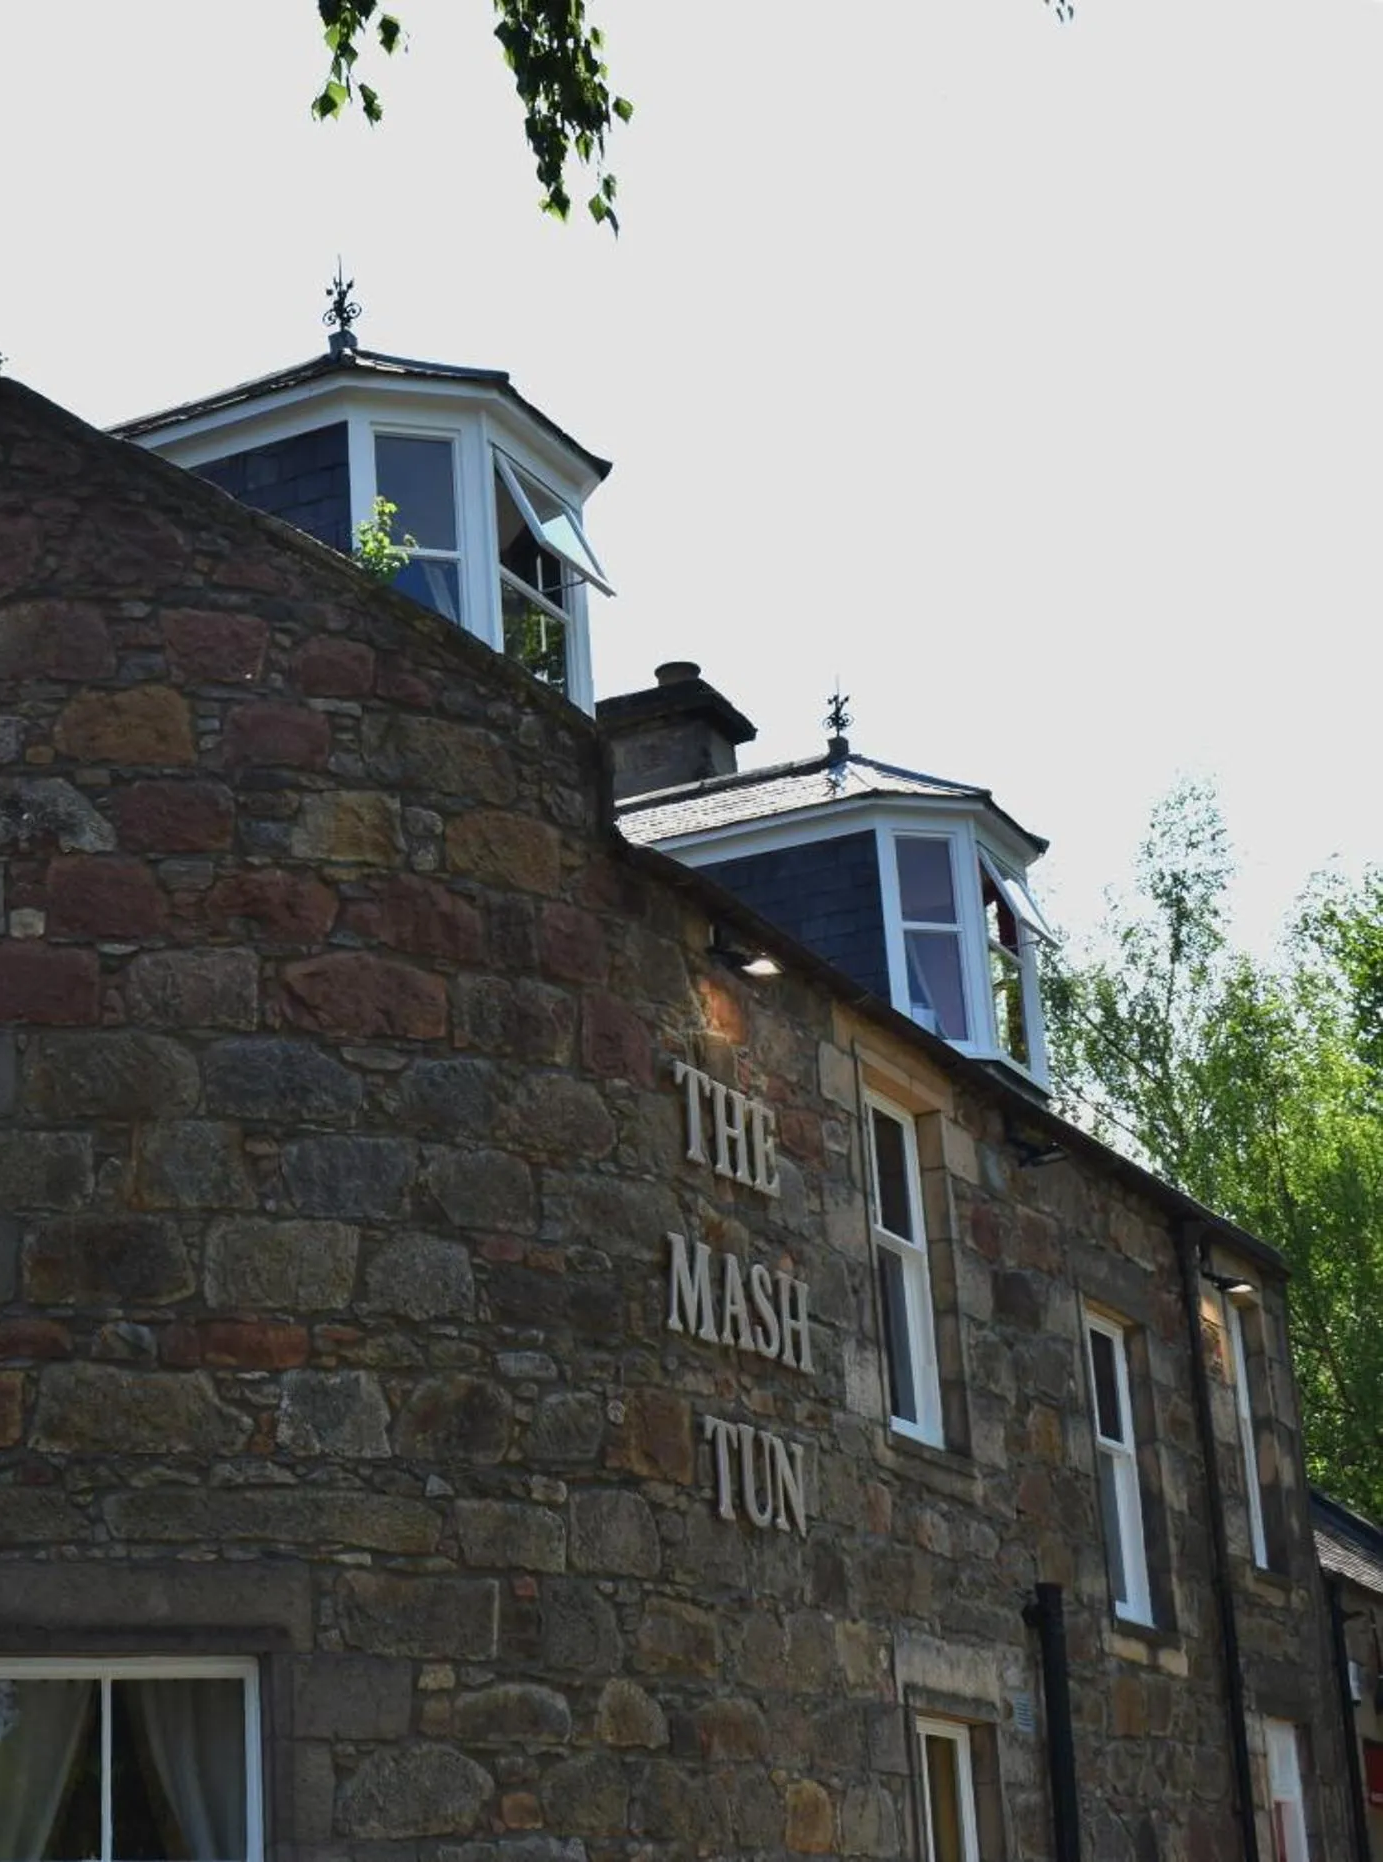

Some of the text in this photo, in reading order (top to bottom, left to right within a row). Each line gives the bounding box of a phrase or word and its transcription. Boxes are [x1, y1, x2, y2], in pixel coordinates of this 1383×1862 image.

[675, 1060, 781, 1197] THE
[666, 1231, 816, 1375] MASH
[704, 1415, 808, 1538] TUN
